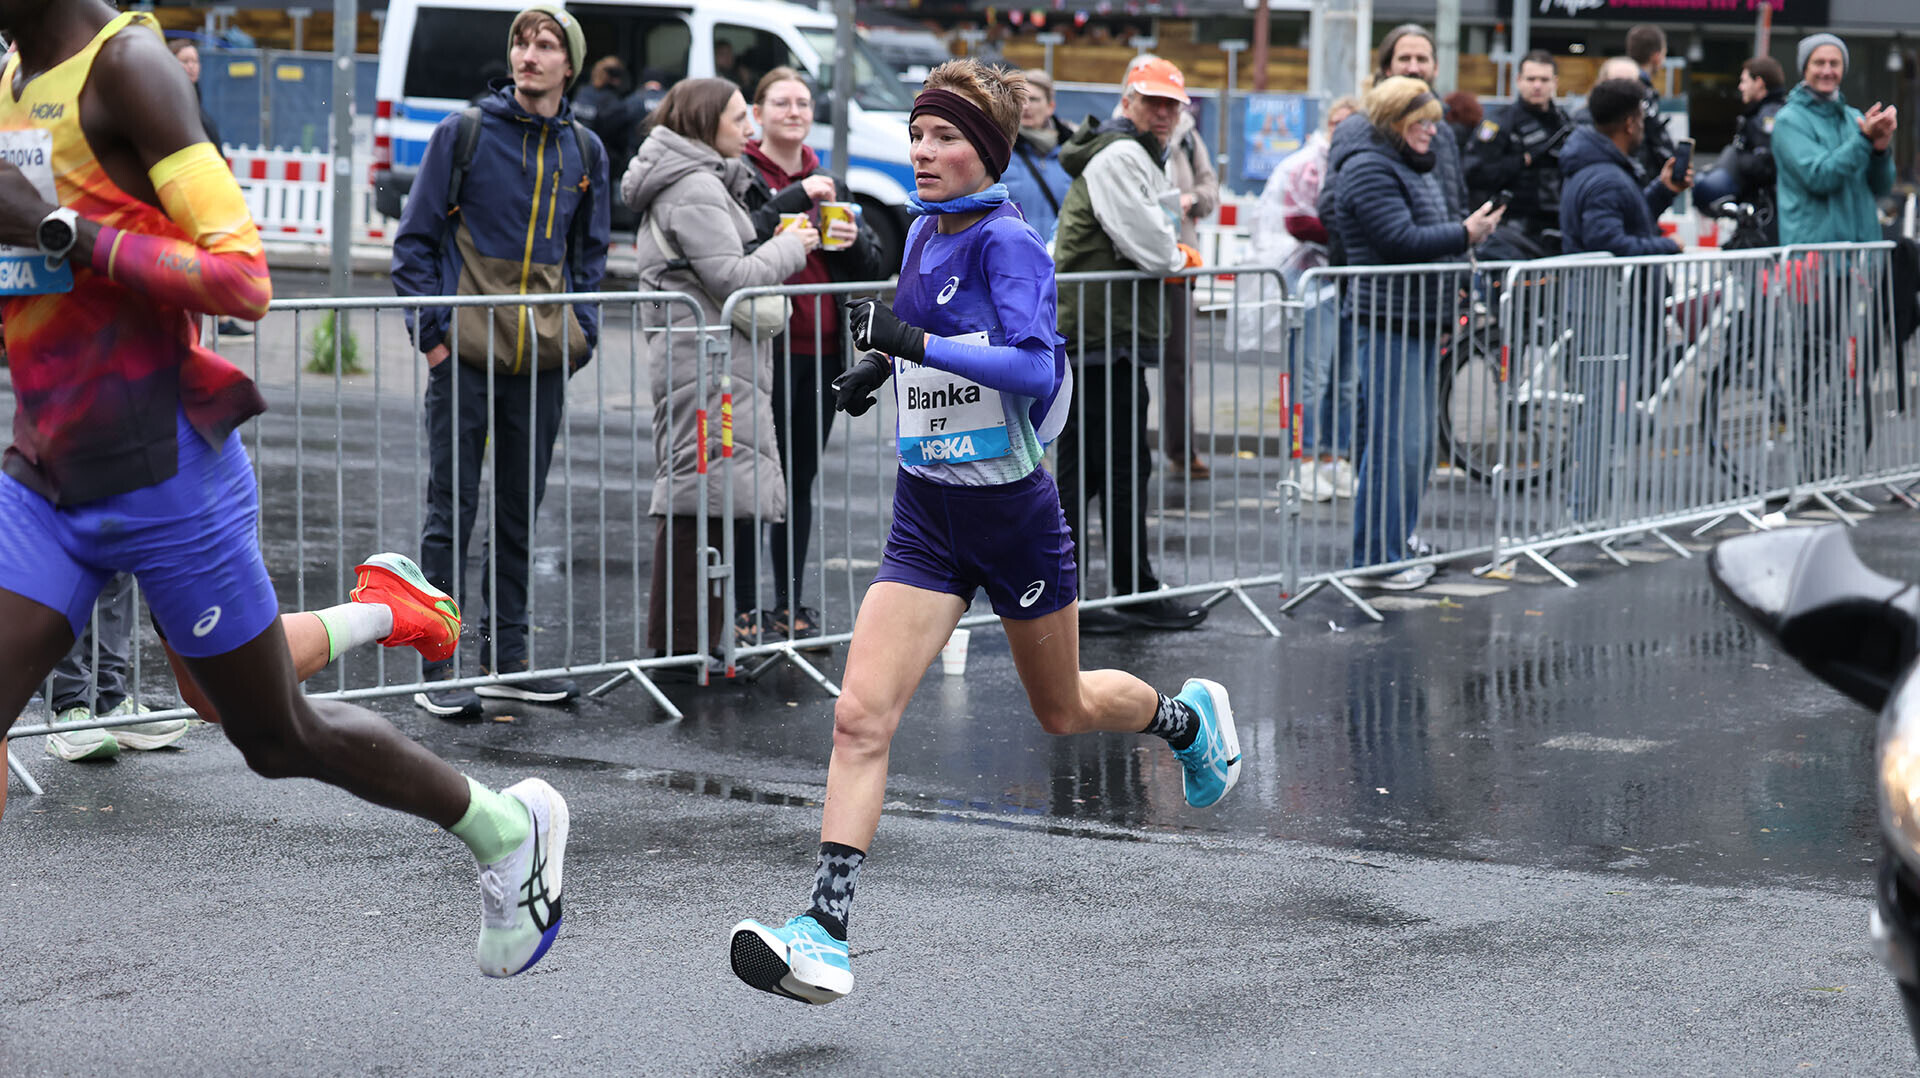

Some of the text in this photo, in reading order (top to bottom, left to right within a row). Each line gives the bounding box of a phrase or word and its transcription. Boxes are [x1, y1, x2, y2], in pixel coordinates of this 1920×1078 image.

[29, 103, 64, 119] HOKA
[156, 249, 201, 275] HOKA
[908, 383, 981, 410] Blanka
[930, 417, 947, 431] F7
[920, 435, 977, 461] HOKA
